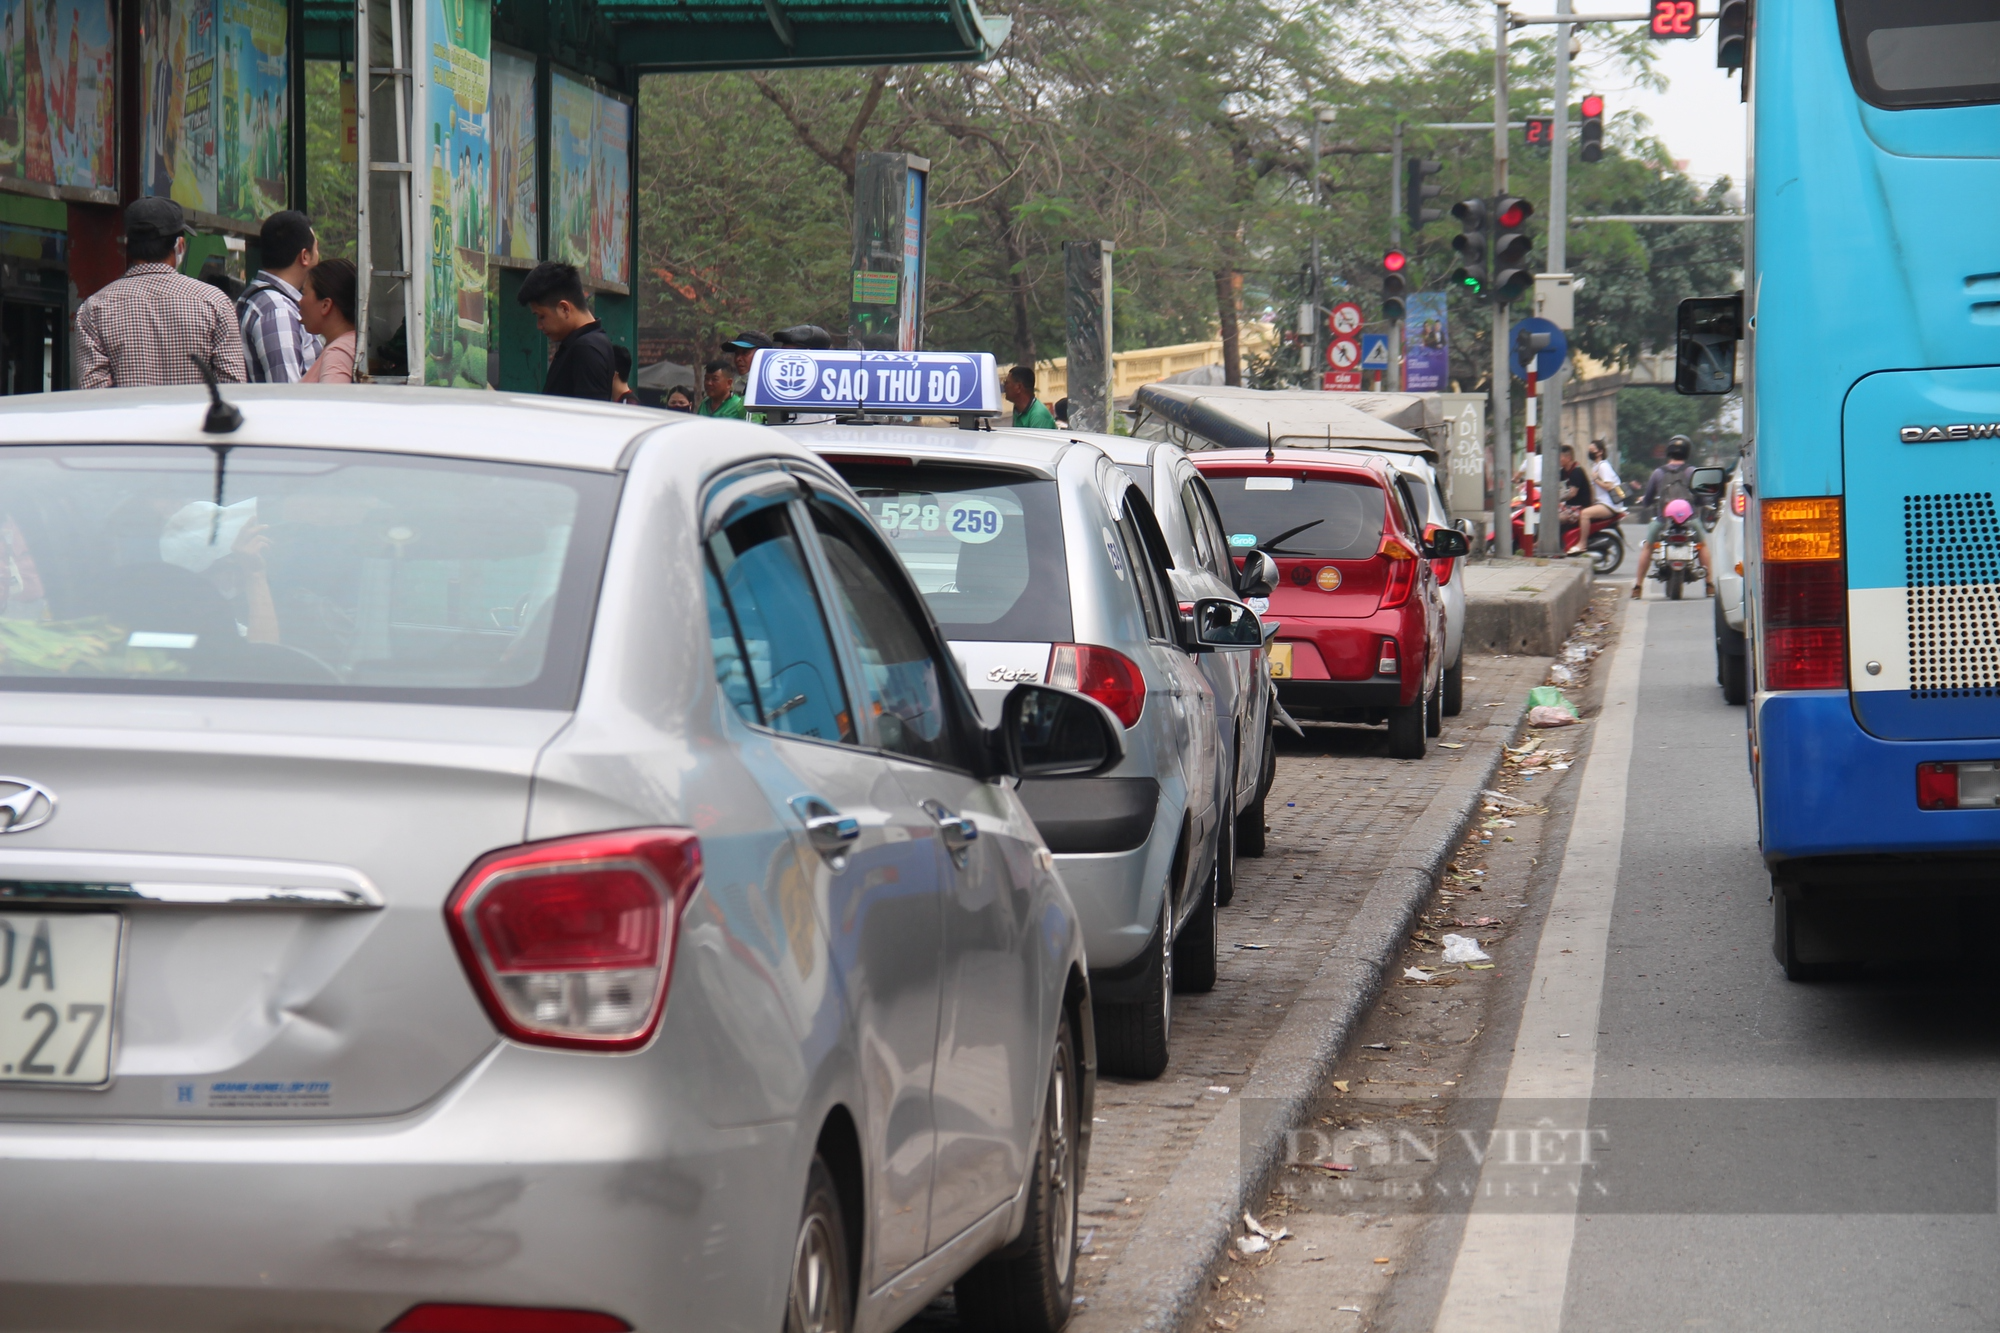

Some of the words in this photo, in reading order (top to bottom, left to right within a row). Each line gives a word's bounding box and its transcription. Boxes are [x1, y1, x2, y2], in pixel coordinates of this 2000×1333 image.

[1652, 1, 1695, 34] 22
[856, 354, 919, 362] TAXI
[780, 361, 805, 378] STĐ
[821, 368, 869, 402] SAO
[876, 363, 921, 402] THỦ
[928, 366, 961, 403] ĐÔ
[1461, 402, 1477, 418] A
[880, 502, 940, 531] 528
[952, 509, 997, 534] 259
[1232, 537, 1255, 545] Grab
[986, 665, 1039, 683] Getz
